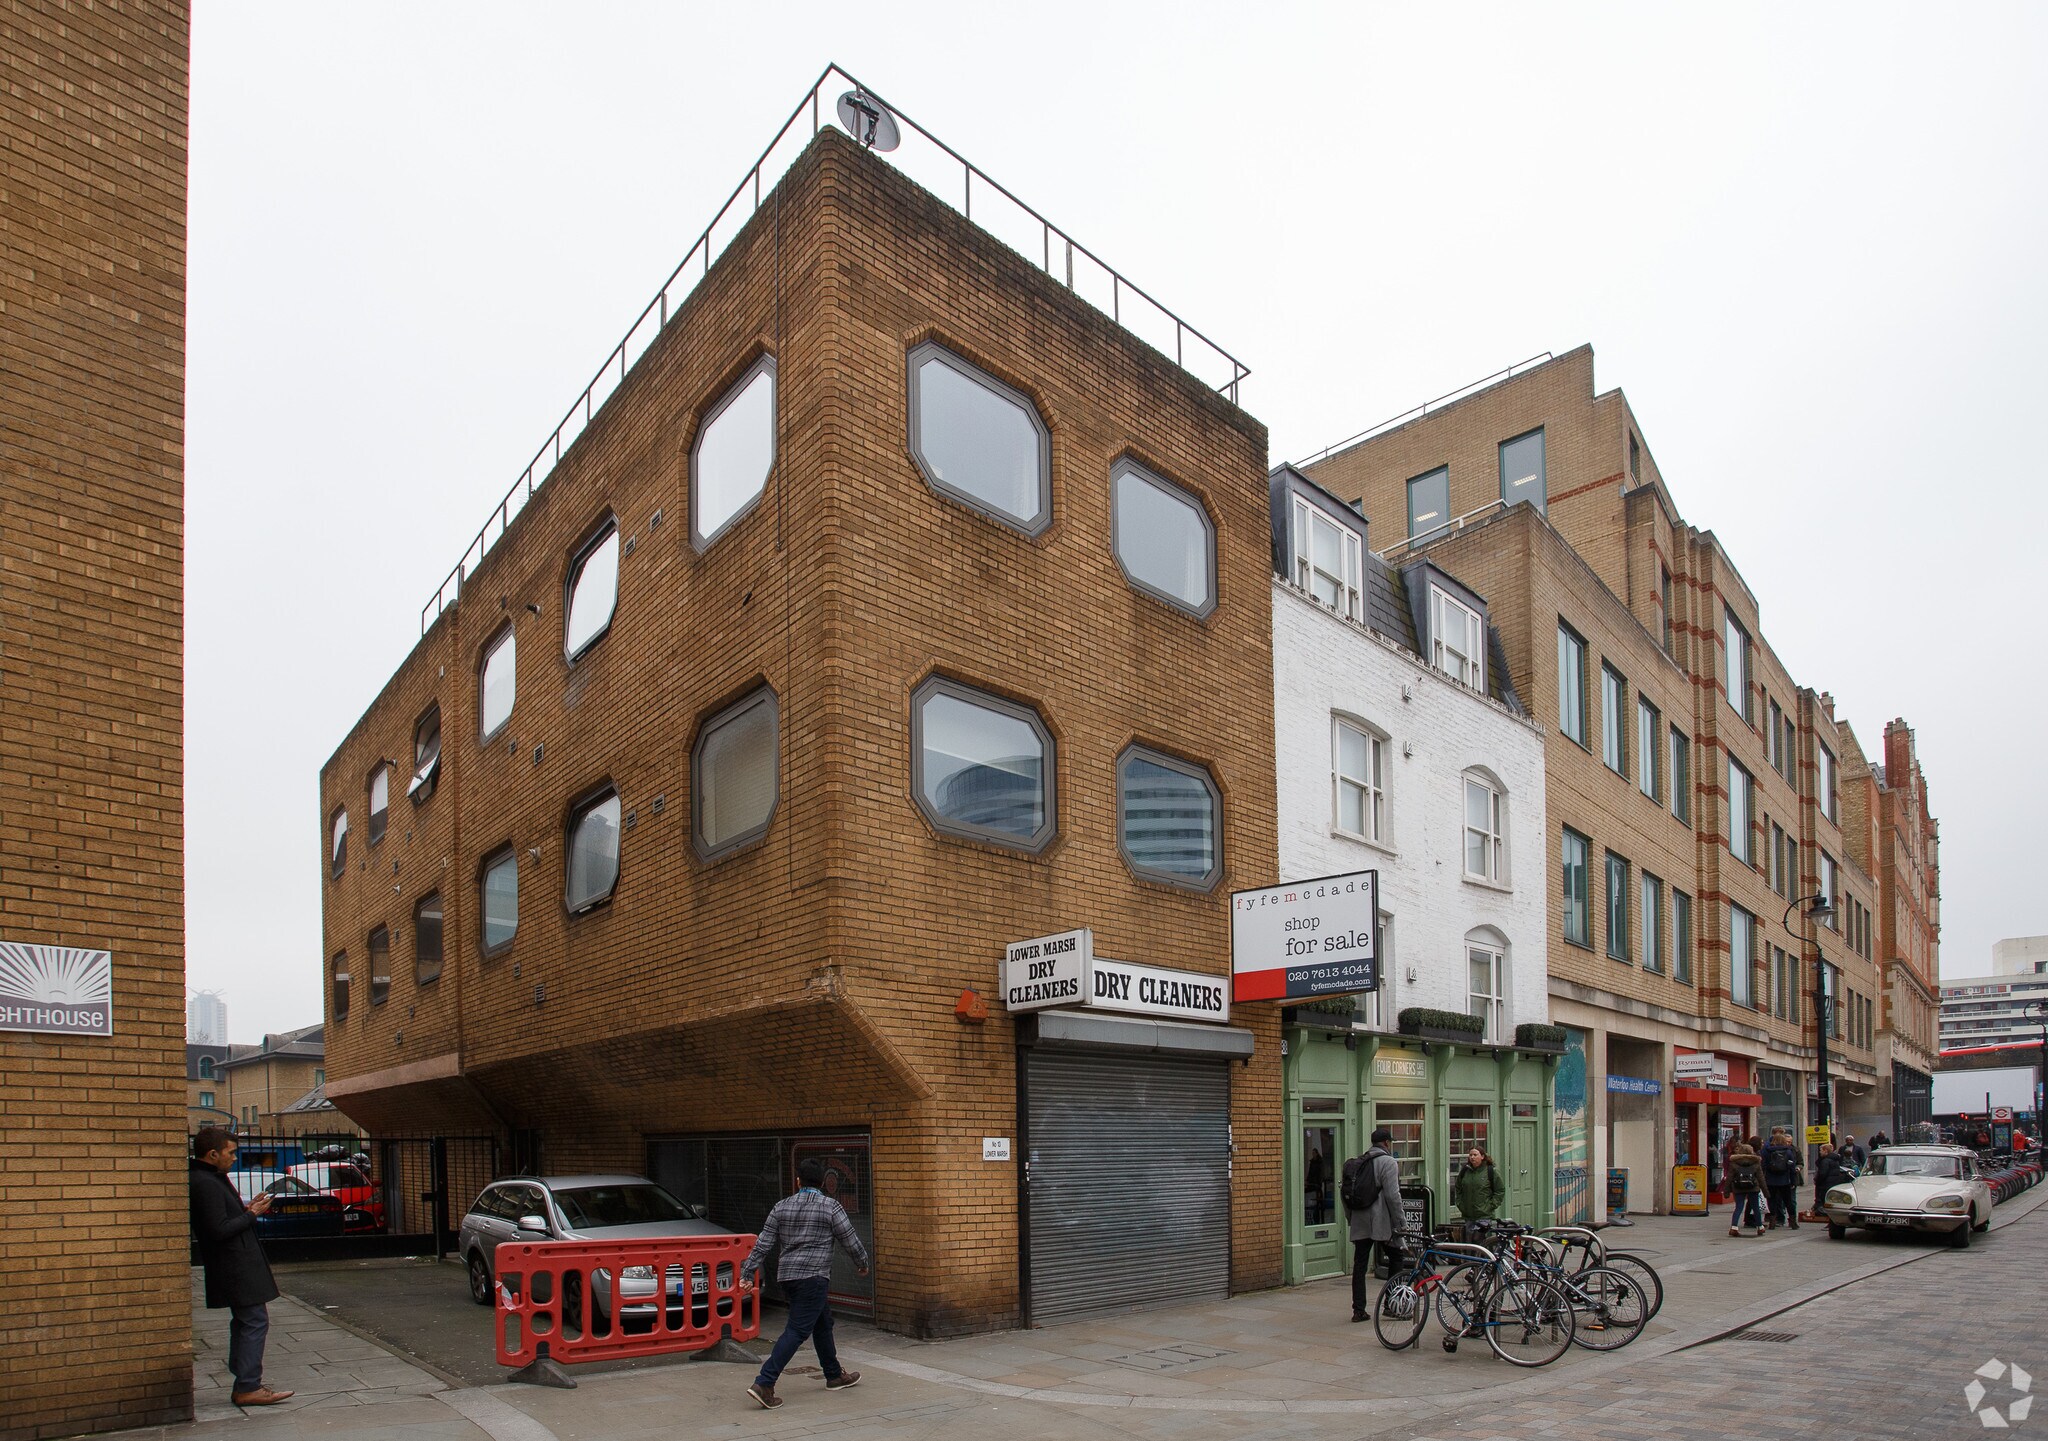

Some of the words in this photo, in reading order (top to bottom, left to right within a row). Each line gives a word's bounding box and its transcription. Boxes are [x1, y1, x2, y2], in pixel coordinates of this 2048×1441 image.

[1236, 881, 1370, 911] fyfemcdade
[1284, 916, 1321, 932] shop
[1010, 943, 1041, 962] LOWER
[1043, 937, 1076, 957] MARSH
[1285, 937, 1318, 957] for
[1324, 930, 1369, 952] sale
[1028, 959, 1056, 980] DRY
[1288, 971, 1309, 982] 020
[1312, 966, 1340, 979] 7613
[1341, 963, 1371, 976] 4044
[1009, 978, 1078, 1004] CLEANERS
[1094, 970, 1131, 1000] DRY
[1139, 976, 1222, 1012] CLEANERS
[1377, 1060, 1391, 1074] FOUR
[1392, 1061, 1416, 1075] CORNERS
[1678, 1059, 1711, 1067] Ryman
[1608, 1076, 1629, 1090] Waterloo
[1629, 1079, 1644, 1092] Health
[1644, 1081, 1658, 1093] Centre
[1406, 1211, 1423, 1221] BEST
[1884, 1216, 1908, 1224] 728K
[1406, 1222, 1423, 1231] SHOP
